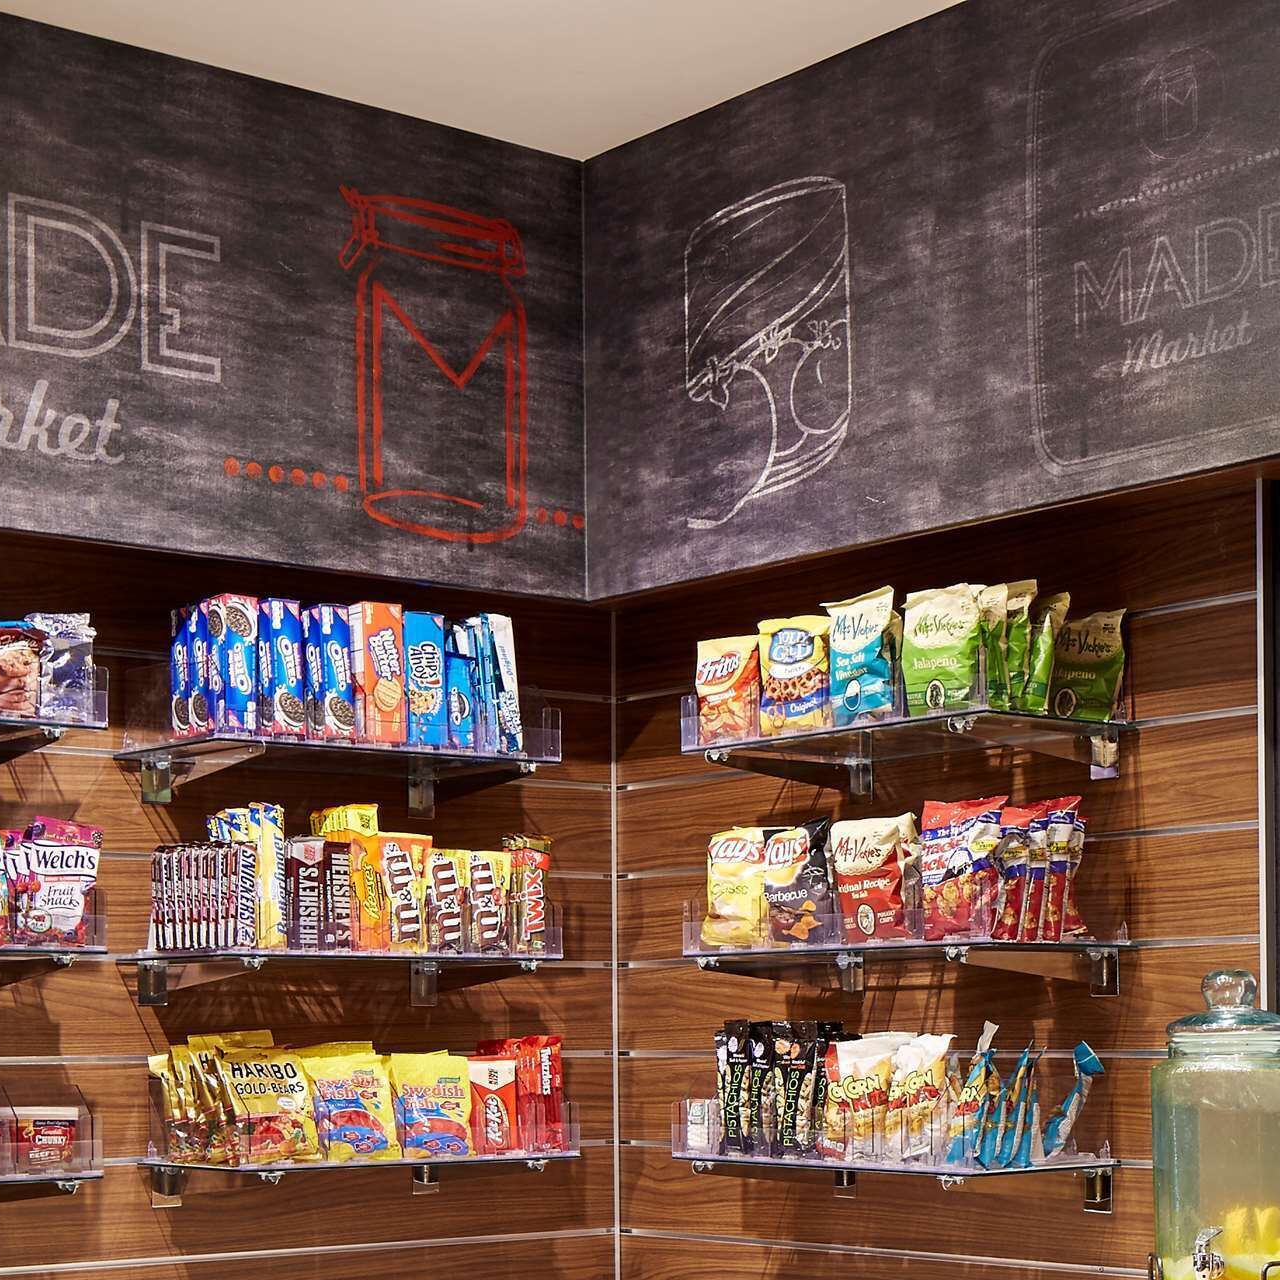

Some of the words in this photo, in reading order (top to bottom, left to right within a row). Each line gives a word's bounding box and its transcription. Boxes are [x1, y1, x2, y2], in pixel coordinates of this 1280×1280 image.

[1121, 311, 1254, 377] Market
[369, 636, 392, 680] Butter
[380, 627, 401, 675] Nutter
[421, 642, 438, 679] Chips
[836, 656, 849, 668] Sea
[850, 653, 865, 664] Salt
[790, 700, 817, 713] Original
[35, 848, 97, 871] Welch's
[47, 884, 76, 898] Fruit
[240, 849, 256, 929] SNICKERS
[863, 878, 891, 890] Recipe
[40, 894, 80, 908] Snacks
[523, 869, 544, 940] TWIX
[765, 889, 808, 903] Barbecue
[299, 866, 319, 949] HERSHEY'S
[231, 1062, 297, 1080] HARIBO
[236, 1081, 304, 1095] GOLD-BEARS
[402, 1084, 465, 1099] Swedish
[727, 1064, 742, 1138] PISTACHIOS
[784, 1071, 799, 1147] PISTACHIOS
[35, 1135, 67, 1146] CHUNKY
